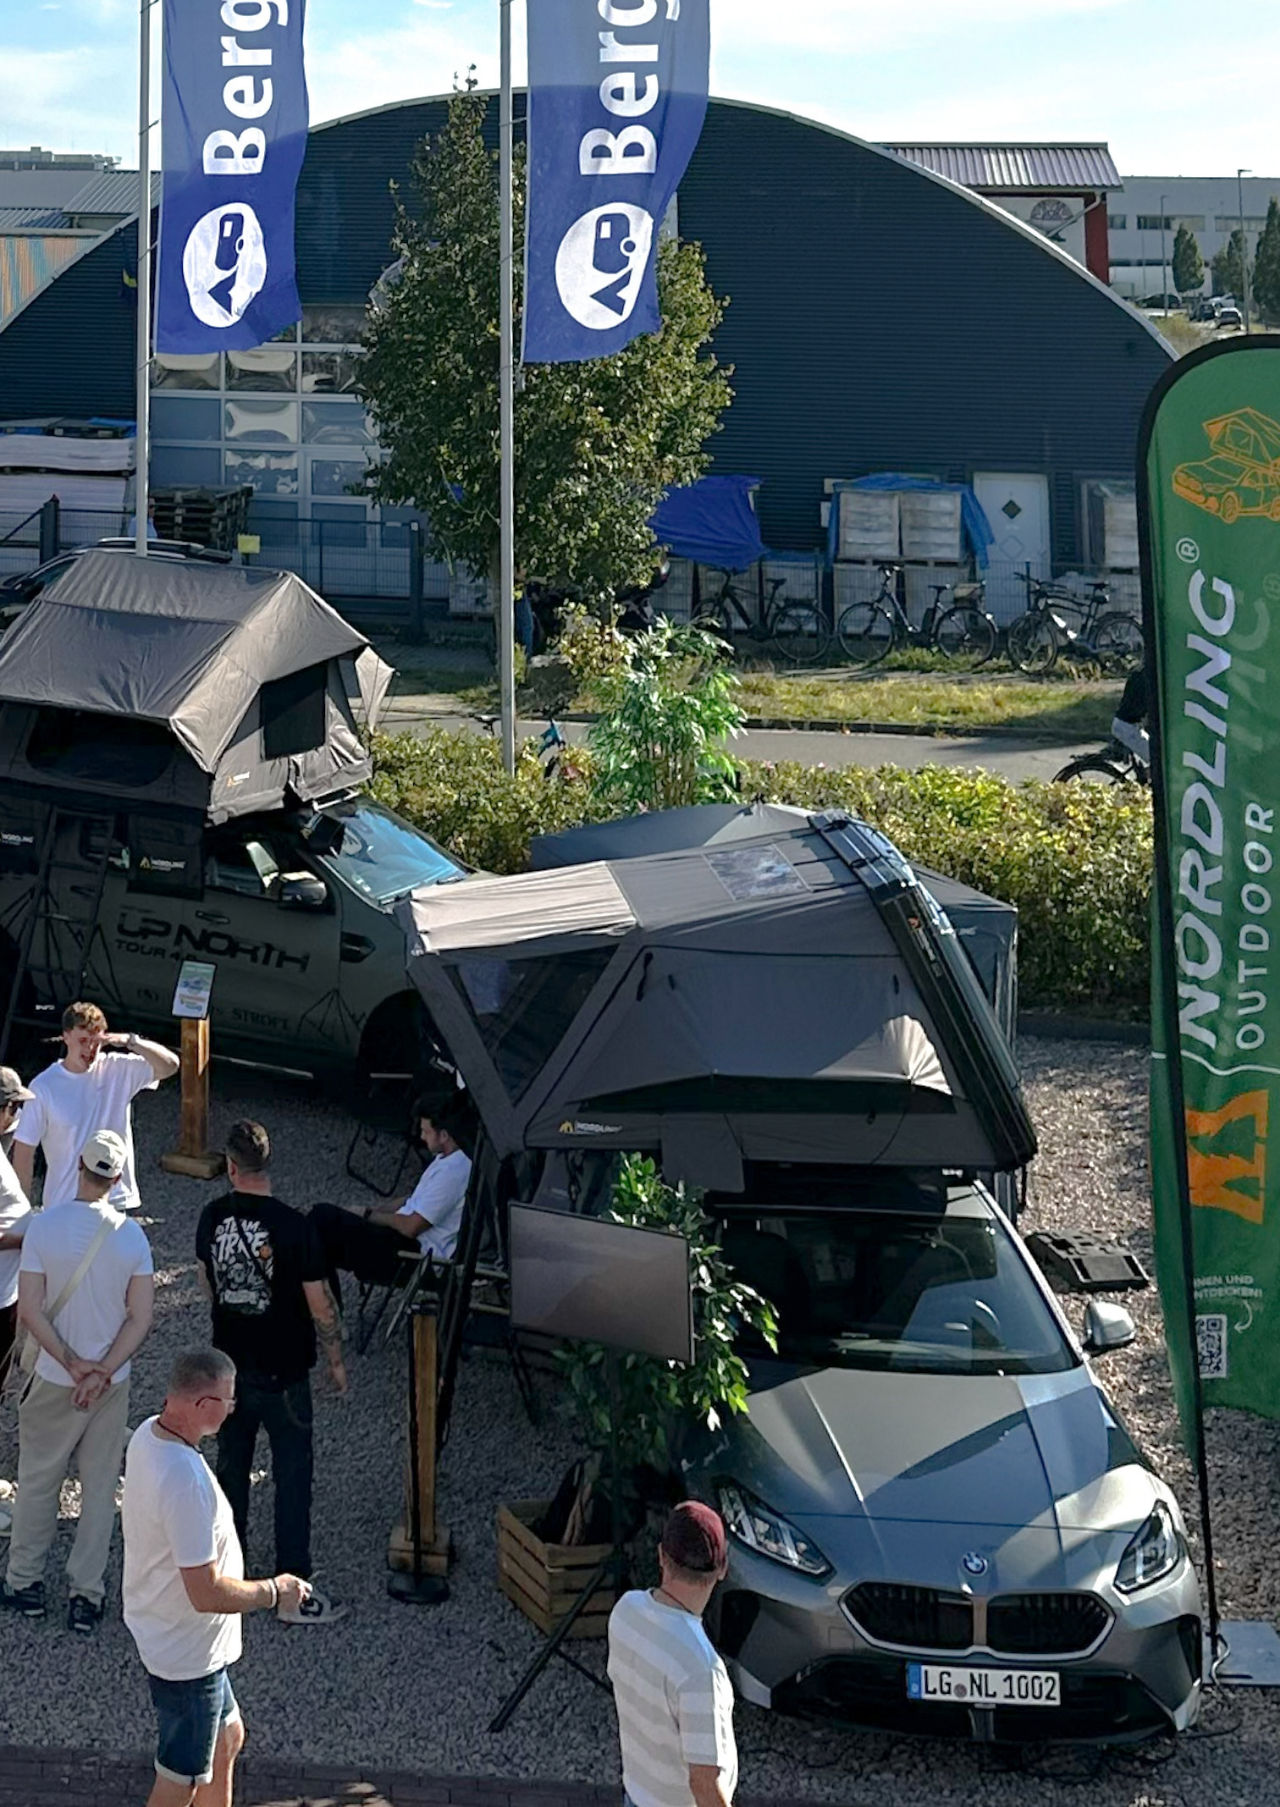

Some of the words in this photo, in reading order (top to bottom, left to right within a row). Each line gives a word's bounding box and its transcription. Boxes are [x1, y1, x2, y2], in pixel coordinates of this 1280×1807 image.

[1236, 802, 1276, 1050] OUTDOOR
[115, 940, 166, 959] TOUR
[117, 912, 172, 939] UP
[174, 924, 310, 972] NORTH
[1225, 1274, 1254, 1285] UND
[1193, 1286, 1263, 1300] NTDECKEN!
[924, 1670, 952, 1695] LG
[970, 1672, 998, 1698] NL
[1003, 1674, 1057, 1701] 1002
